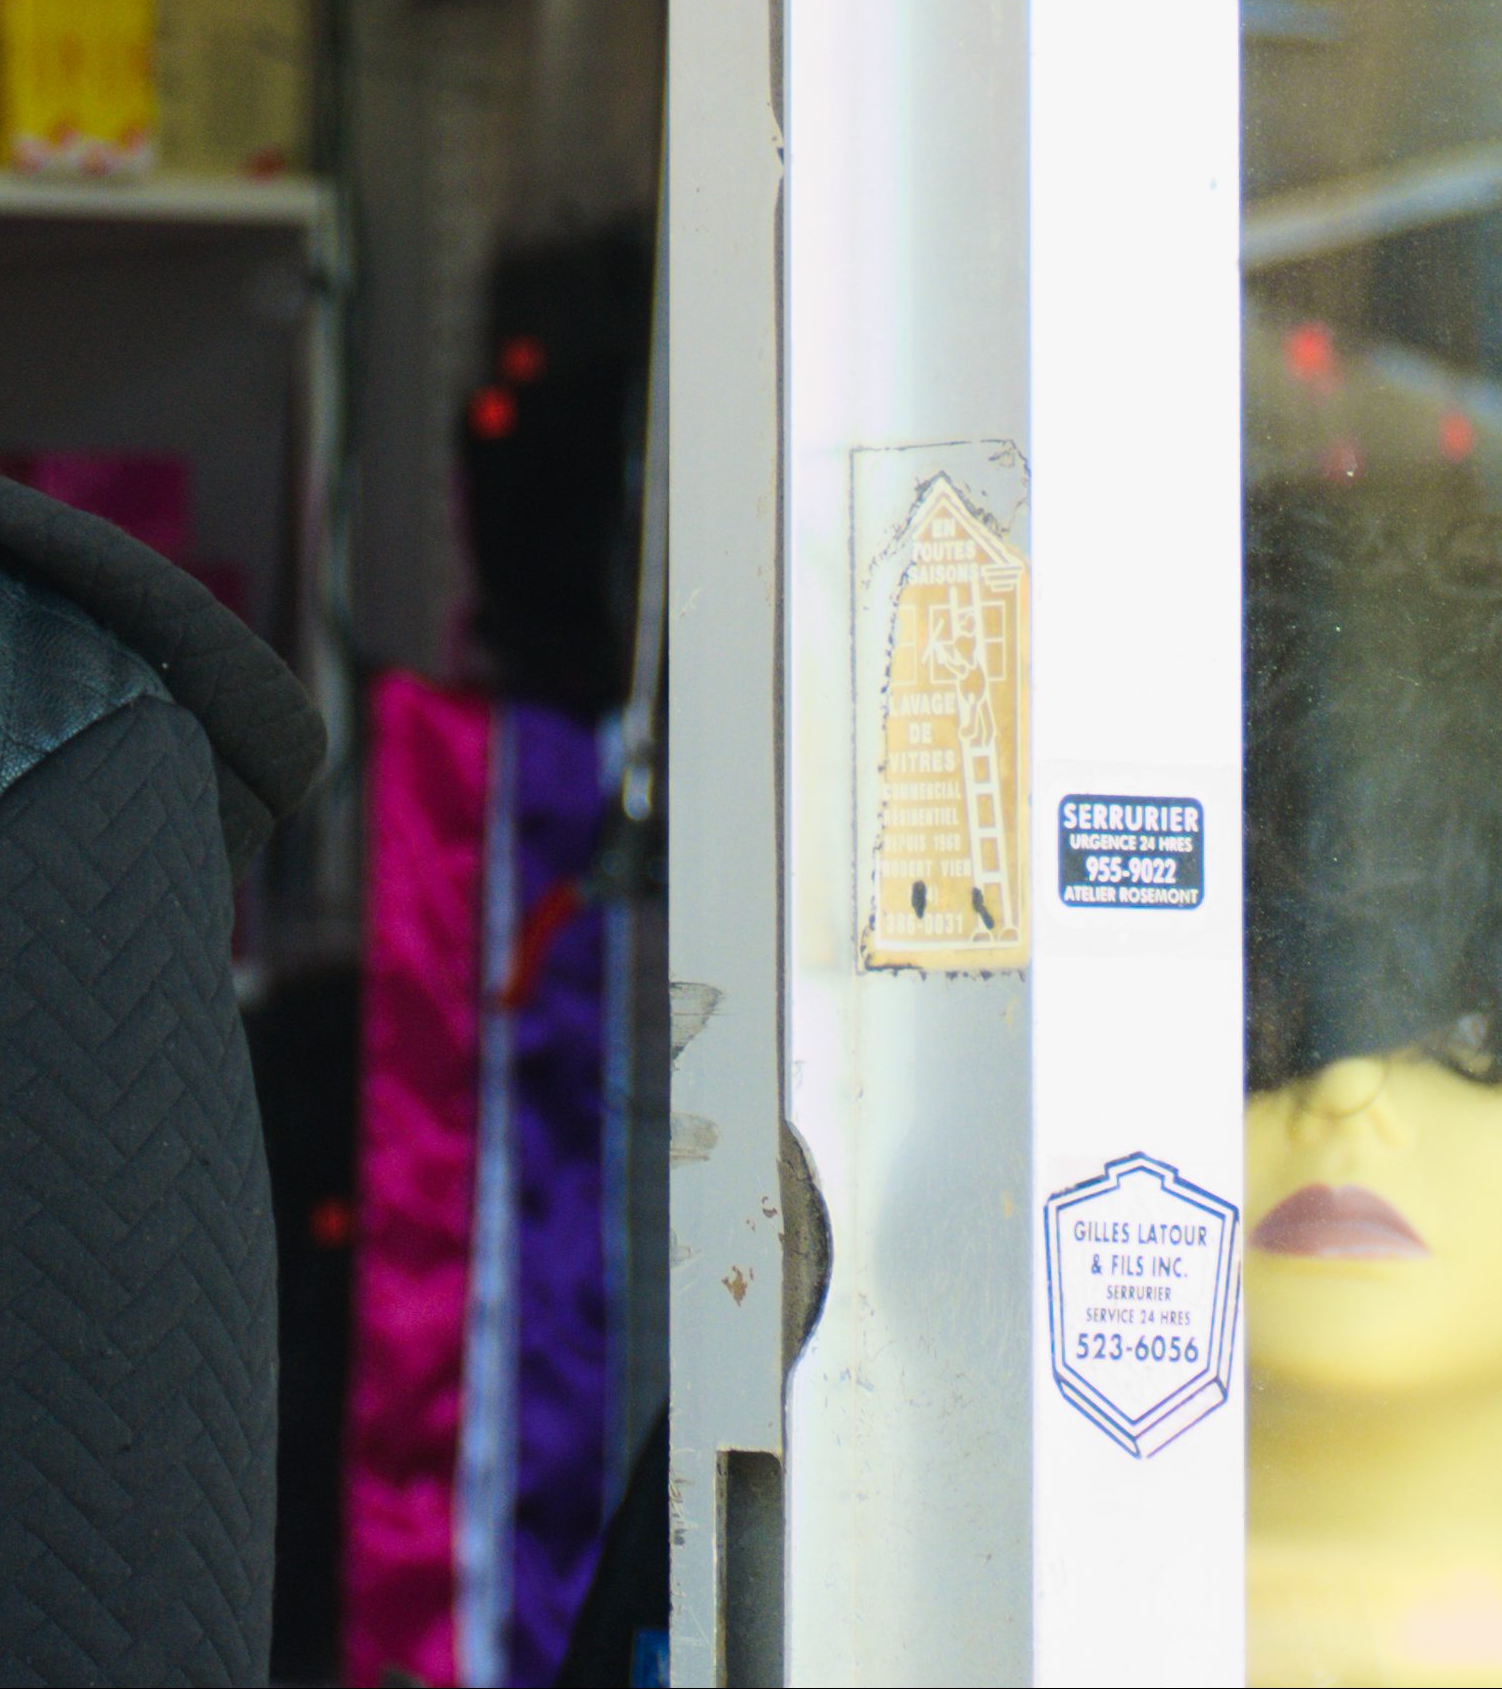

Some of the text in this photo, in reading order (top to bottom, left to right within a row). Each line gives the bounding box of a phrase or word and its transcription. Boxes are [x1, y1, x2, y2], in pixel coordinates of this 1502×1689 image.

[931, 518, 957, 538] EN
[911, 539, 976, 561] TOUTES
[889, 692, 957, 716] LAVAGE
[908, 722, 934, 744] DE
[888, 750, 956, 773] VITRES
[1063, 802, 1199, 832] SERRURIER
[1070, 833, 1193, 853] URGENCE 24 HRES
[1085, 855, 1177, 884] 955-9022
[1064, 885, 1199, 904] ATELIER ROSEMONT
[1074, 1220, 1208, 1247] GILLES LATOUR
[1091, 1253, 1188, 1279] & FILS INC.
[1106, 1285, 1172, 1302] SERRURIER
[1086, 1307, 1191, 1326] SERVICE 24 HRES
[1076, 1331, 1199, 1364] 523-6056
